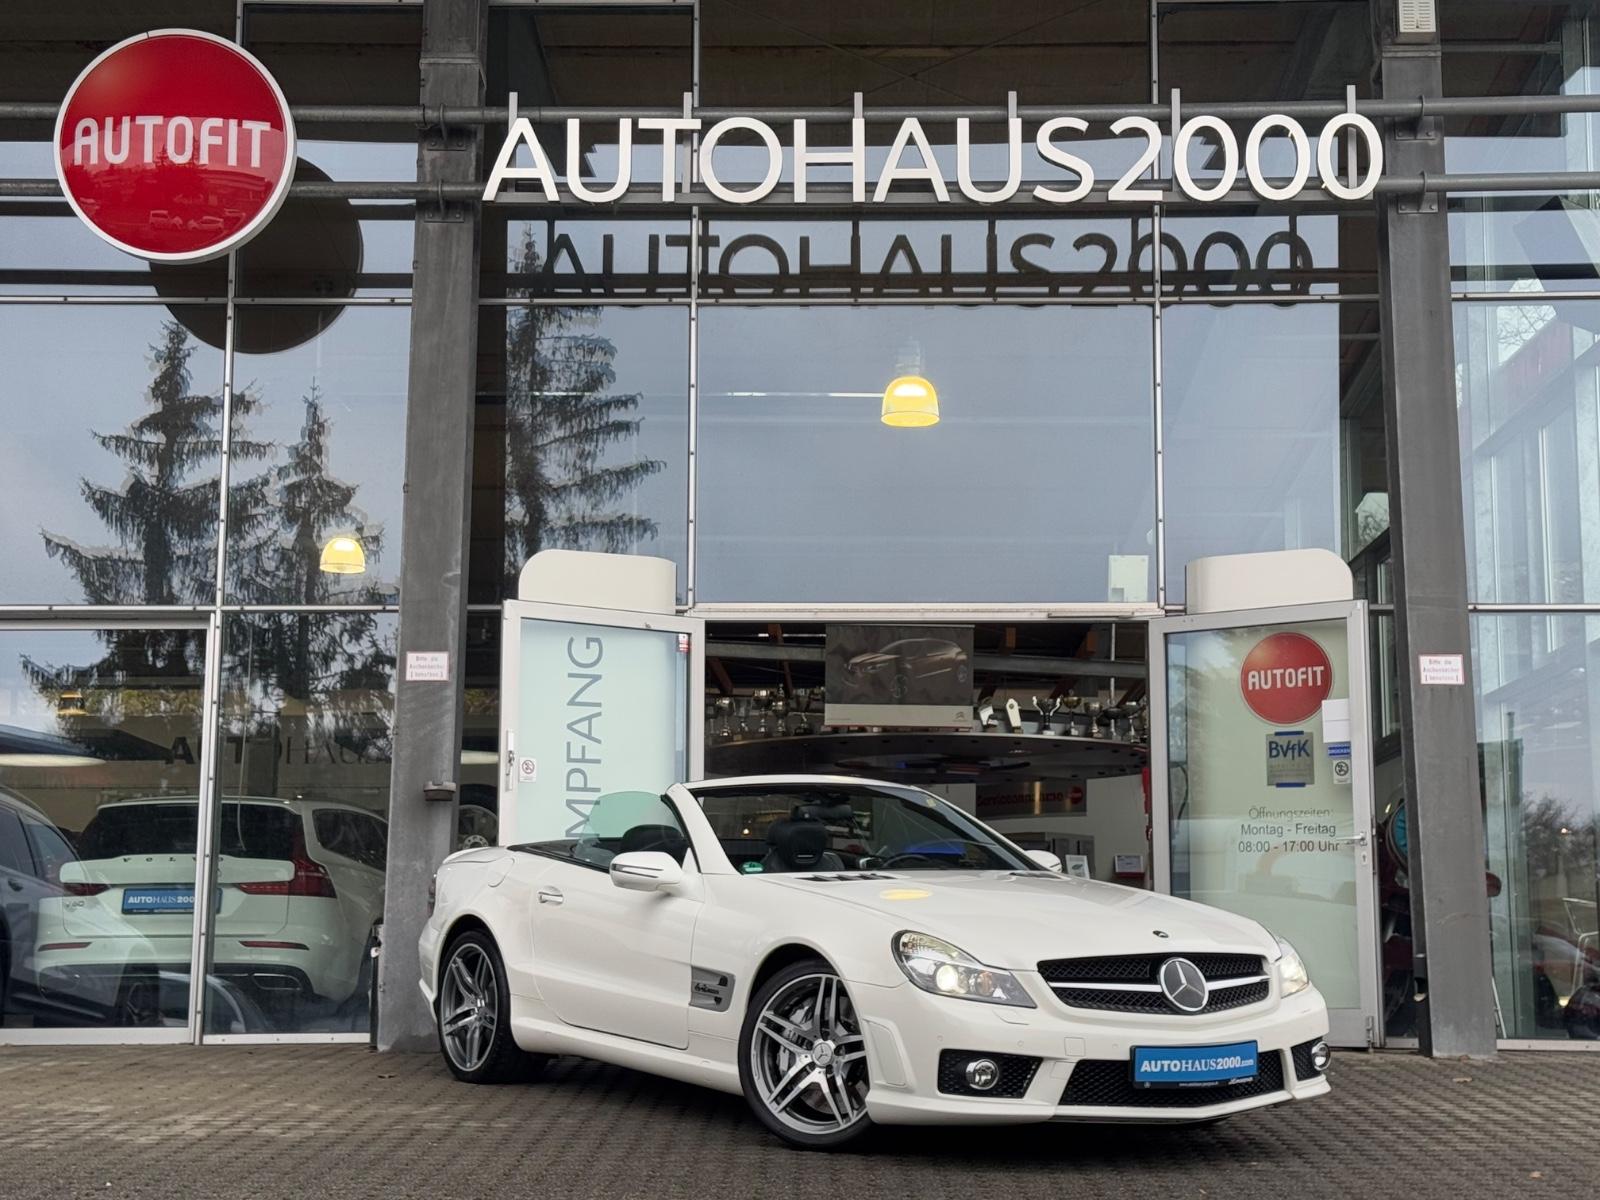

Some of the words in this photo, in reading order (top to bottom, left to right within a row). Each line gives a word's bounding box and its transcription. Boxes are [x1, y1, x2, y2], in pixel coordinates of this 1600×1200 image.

[74, 115, 271, 168] AUTOFIT
[482, 113, 1383, 203] AUTOHAUS2000
[1248, 666, 1325, 690] AUTOFIT
[565, 636, 603, 838] MPFANG
[1248, 804, 1334, 820] Öffnungszeiten:
[1241, 824, 1283, 837] Montag
[1295, 822, 1336, 837] Freitag
[1238, 840, 1270, 853] 08:00
[1283, 840, 1315, 853] 17:00
[1318, 840, 1340, 852] Uhr
[127, 896, 196, 904] AUTOHAUS200
